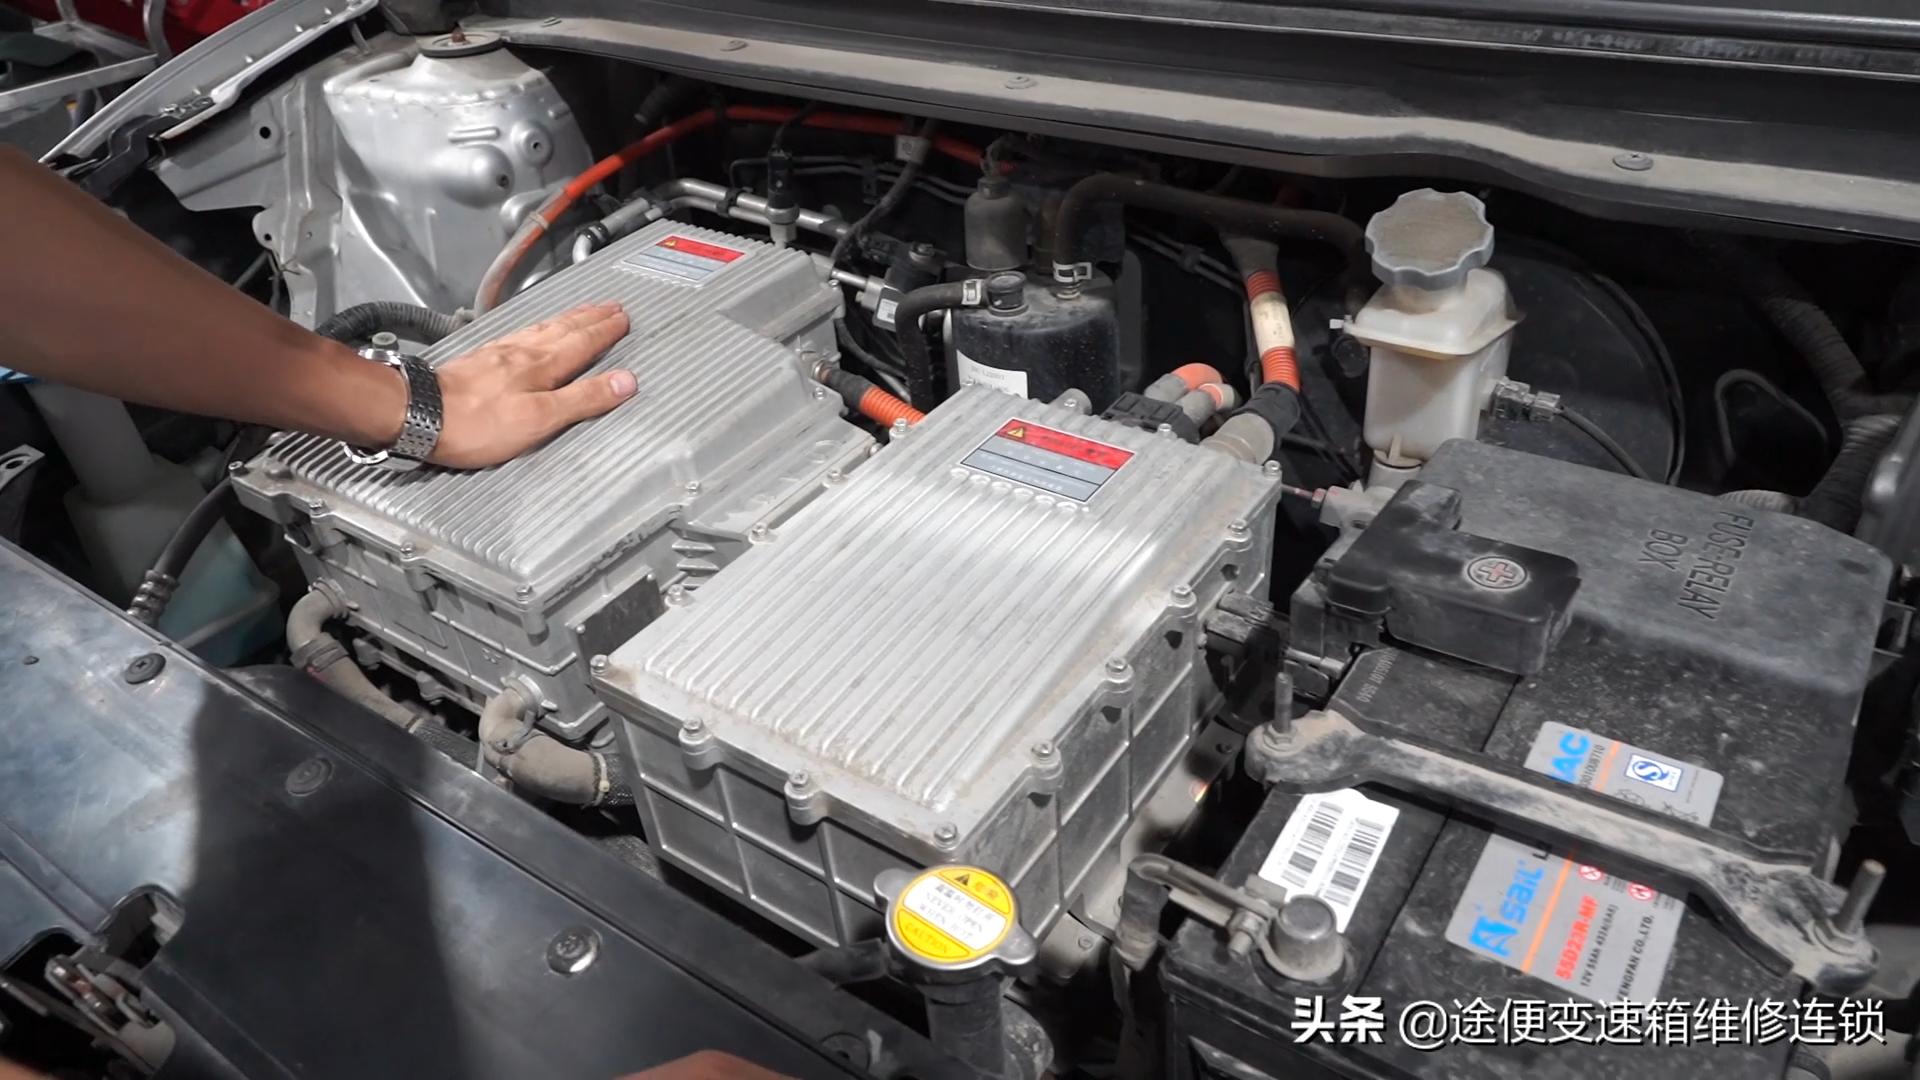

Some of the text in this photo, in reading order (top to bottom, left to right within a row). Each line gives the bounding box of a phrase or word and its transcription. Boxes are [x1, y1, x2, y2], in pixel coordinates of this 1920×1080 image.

[1638, 528, 1688, 571] BOX
[1677, 510, 1754, 620] FUSE-RELAY
[1550, 730, 1591, 785] AC
